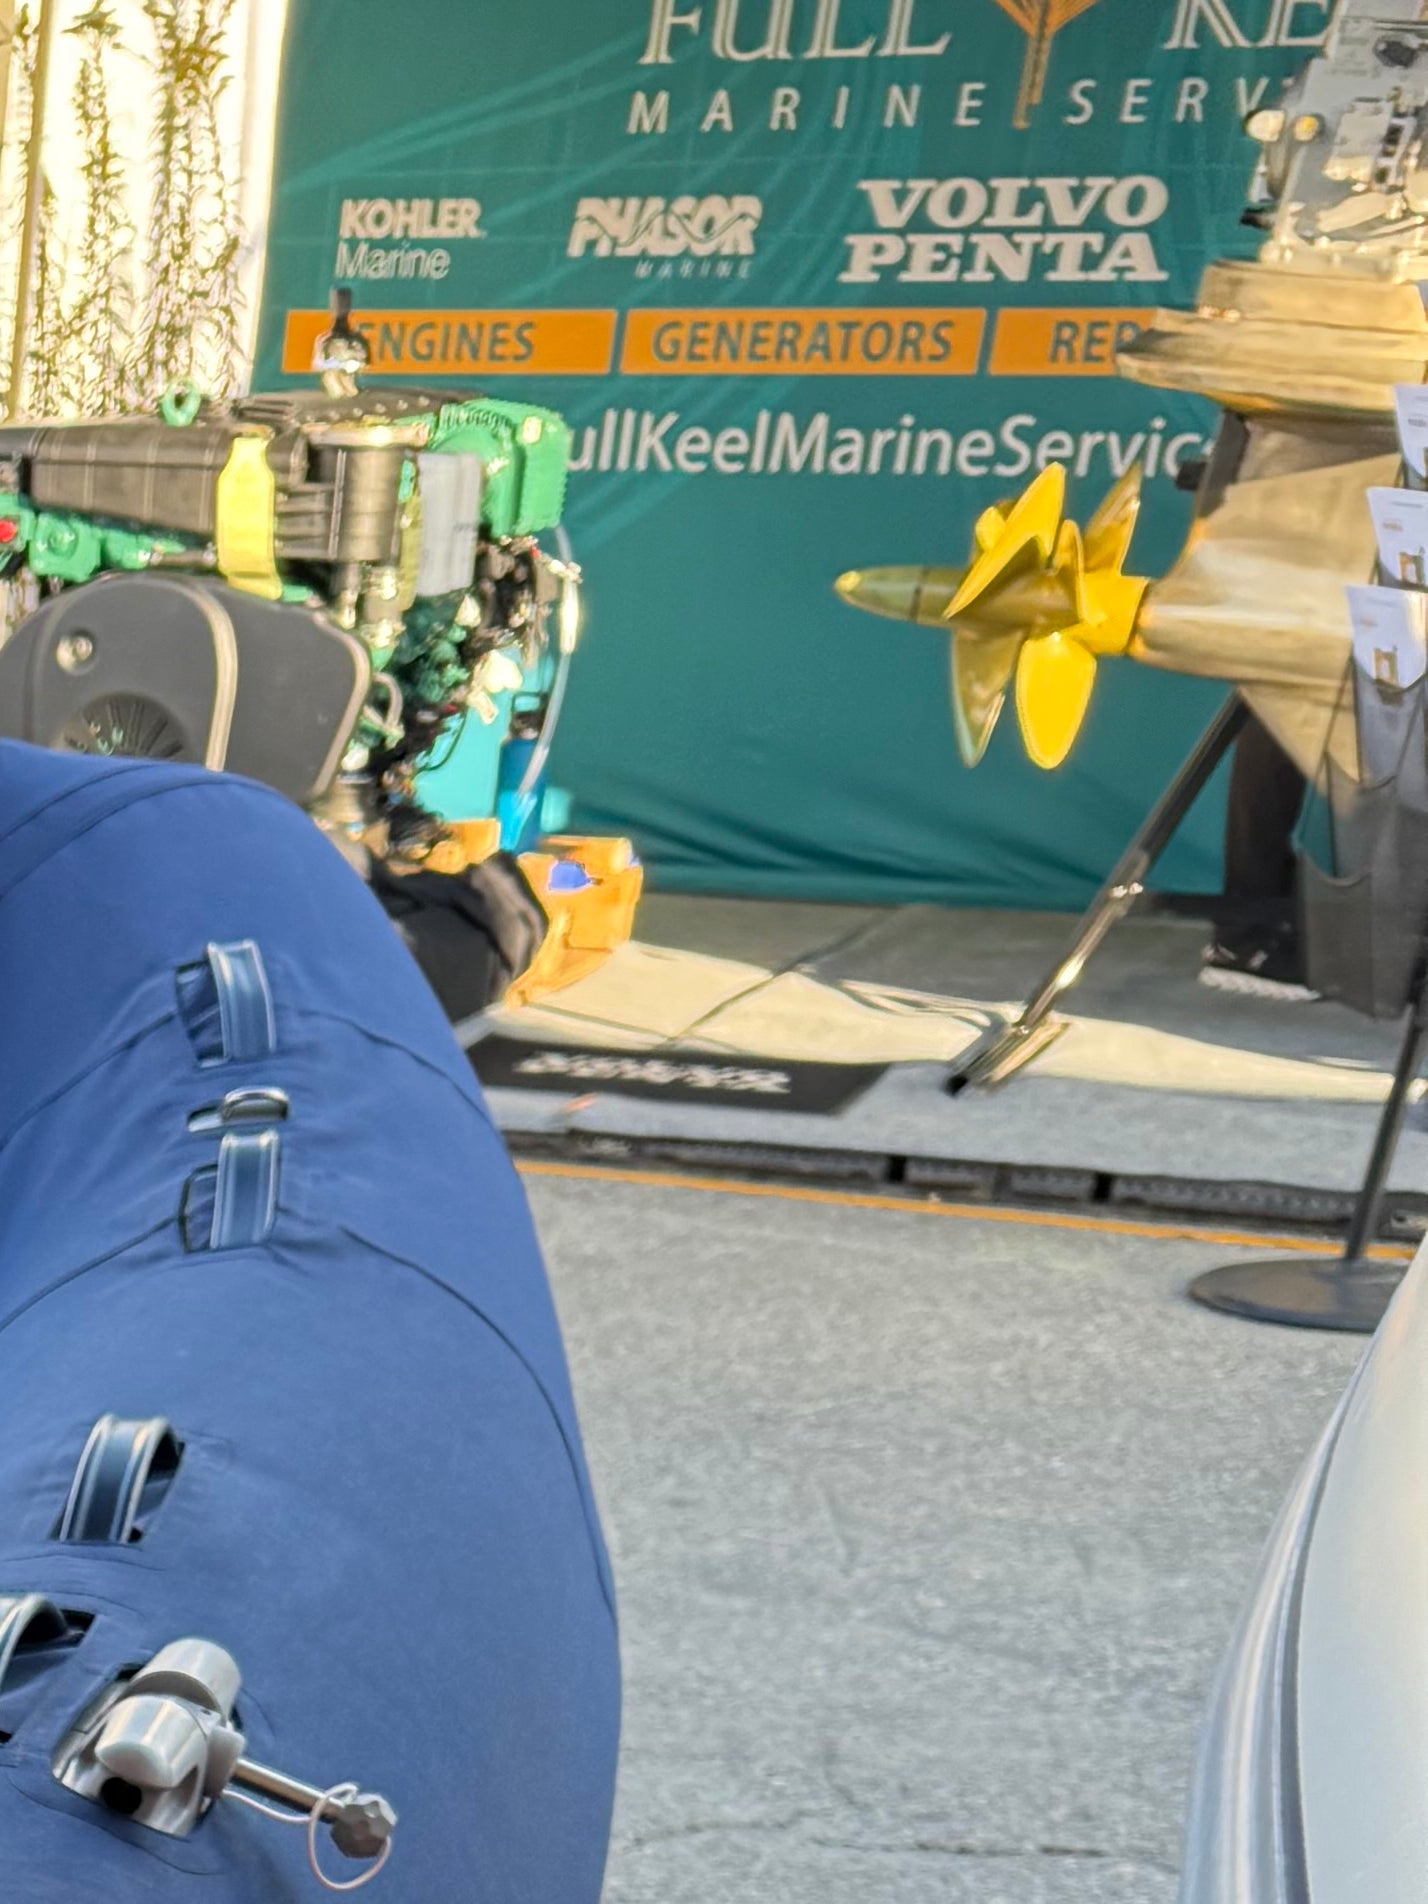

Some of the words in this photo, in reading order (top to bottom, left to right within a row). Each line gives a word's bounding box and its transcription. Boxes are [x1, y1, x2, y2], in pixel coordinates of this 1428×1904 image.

[639, 0, 952, 65] FULL
[626, 82, 986, 134] MARINE
[1064, 76, 1295, 124] SERV
[339, 198, 485, 238] KOHLER
[567, 195, 764, 258] PHASOR
[857, 175, 1169, 229] VOLVO
[336, 243, 451, 280] Marine
[635, 260, 754, 278] MARINE
[837, 232, 1169, 283] PENTA
[652, 320, 955, 363] GENERATORS
[568, 407, 1216, 478] ullKeelMarineServic
